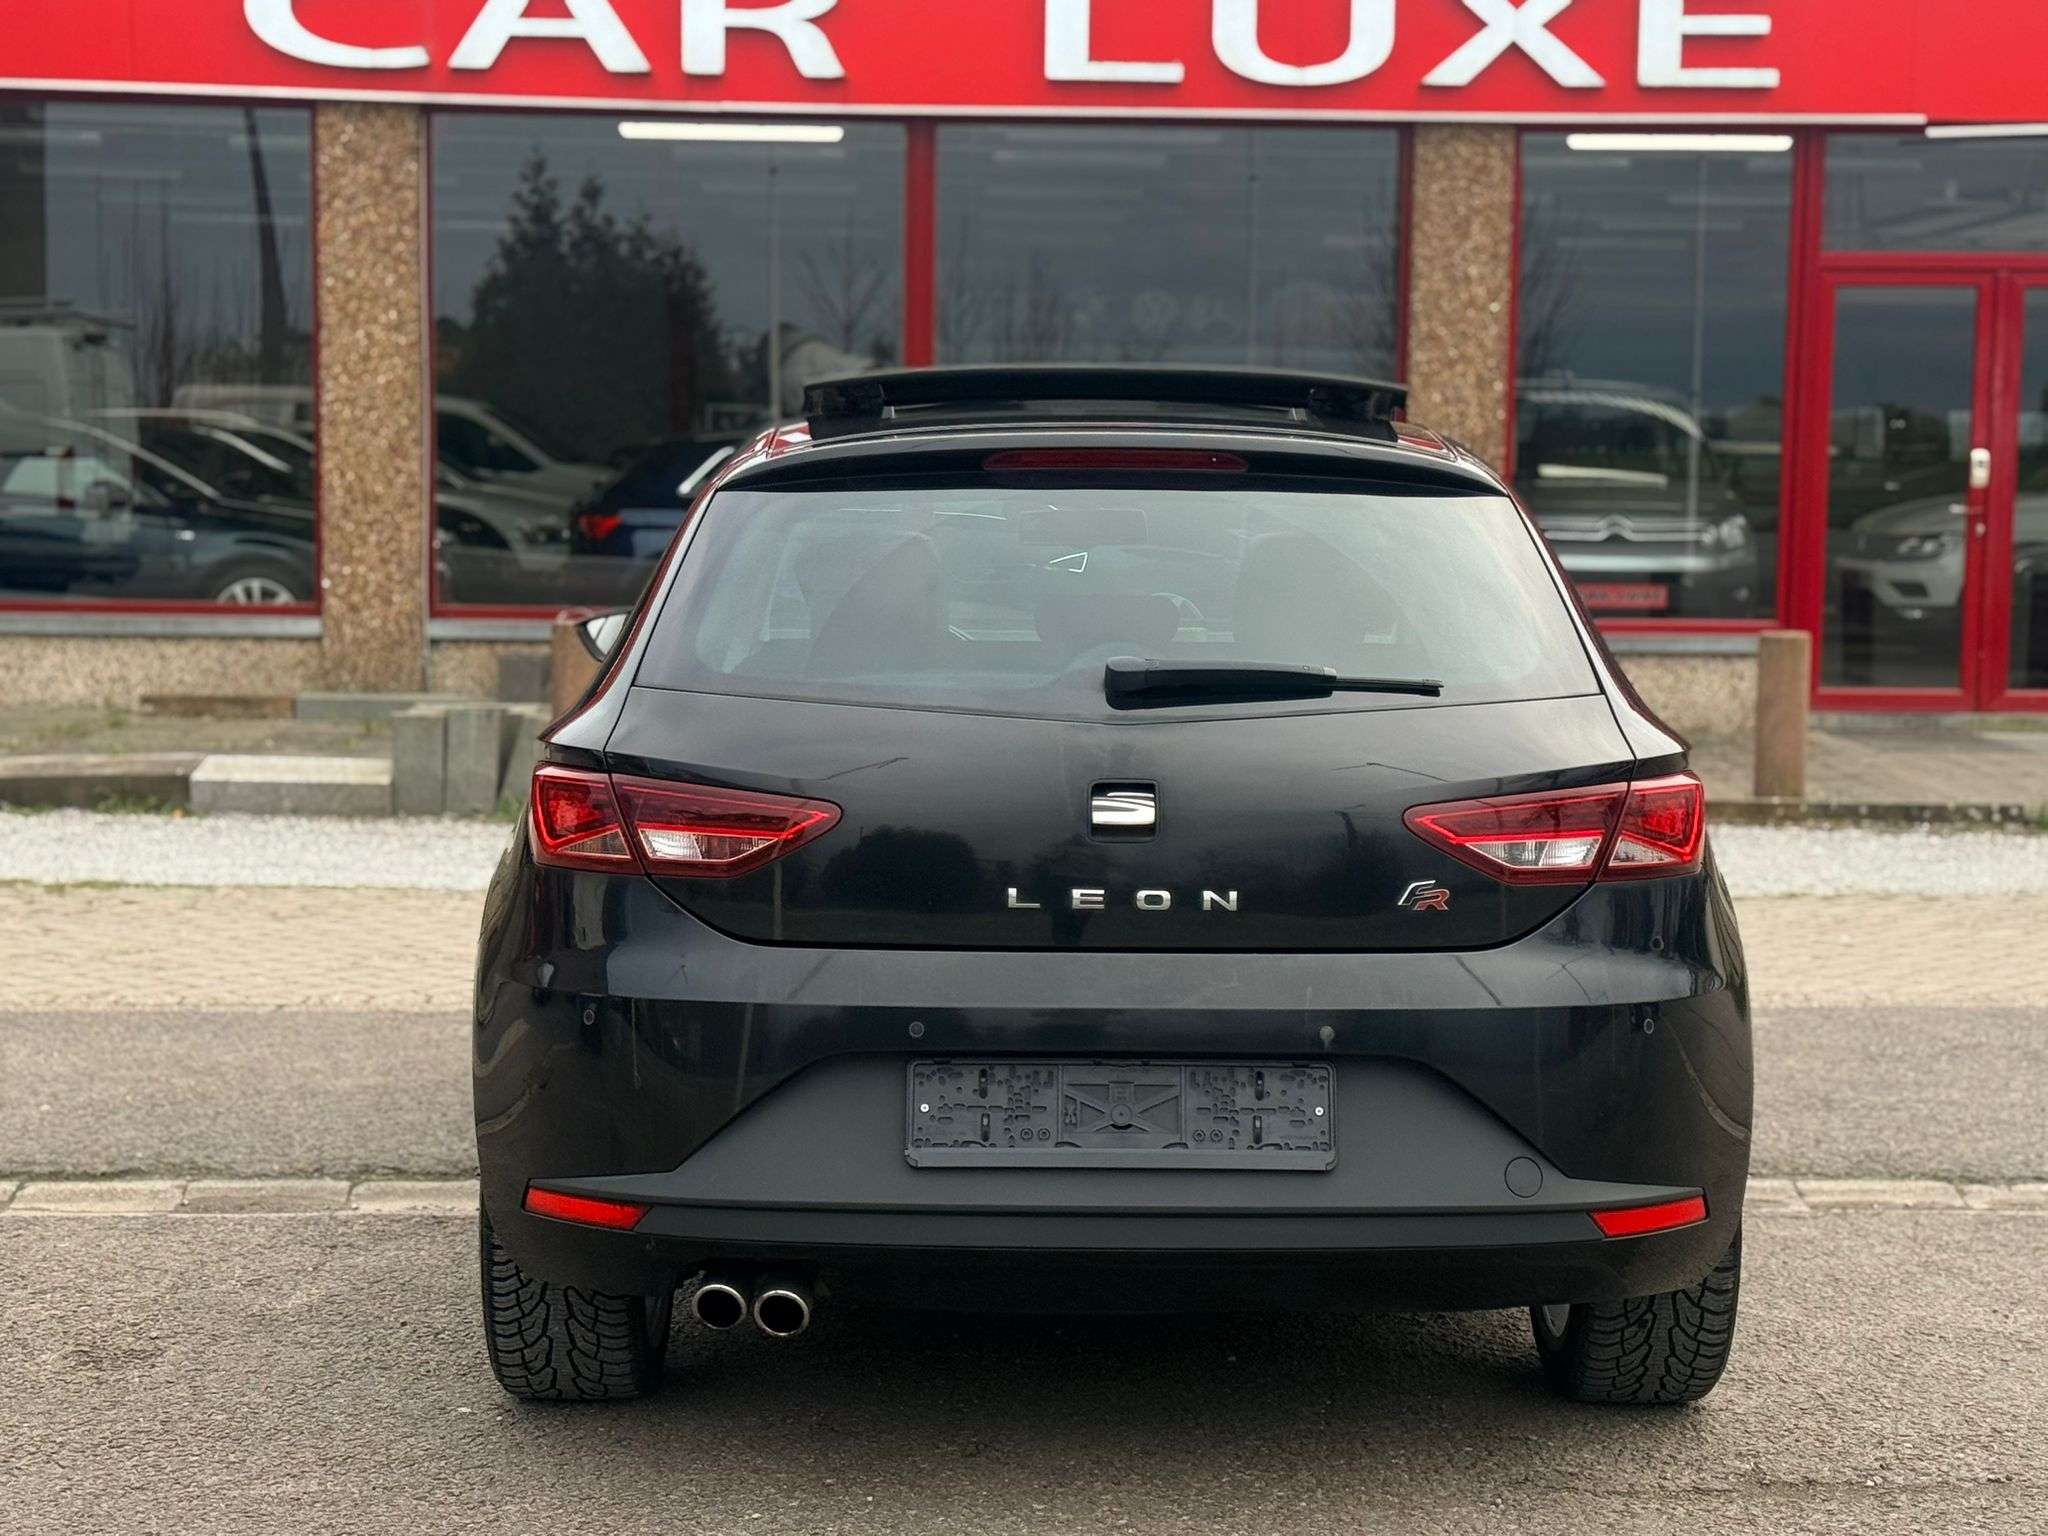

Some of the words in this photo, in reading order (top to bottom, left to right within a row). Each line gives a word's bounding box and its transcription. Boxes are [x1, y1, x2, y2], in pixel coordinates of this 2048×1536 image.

[243, 0, 846, 79] CAR
[1042, 0, 1781, 89] LUXE
[1006, 887, 1239, 911] LEON
[1397, 879, 1450, 911] FR
